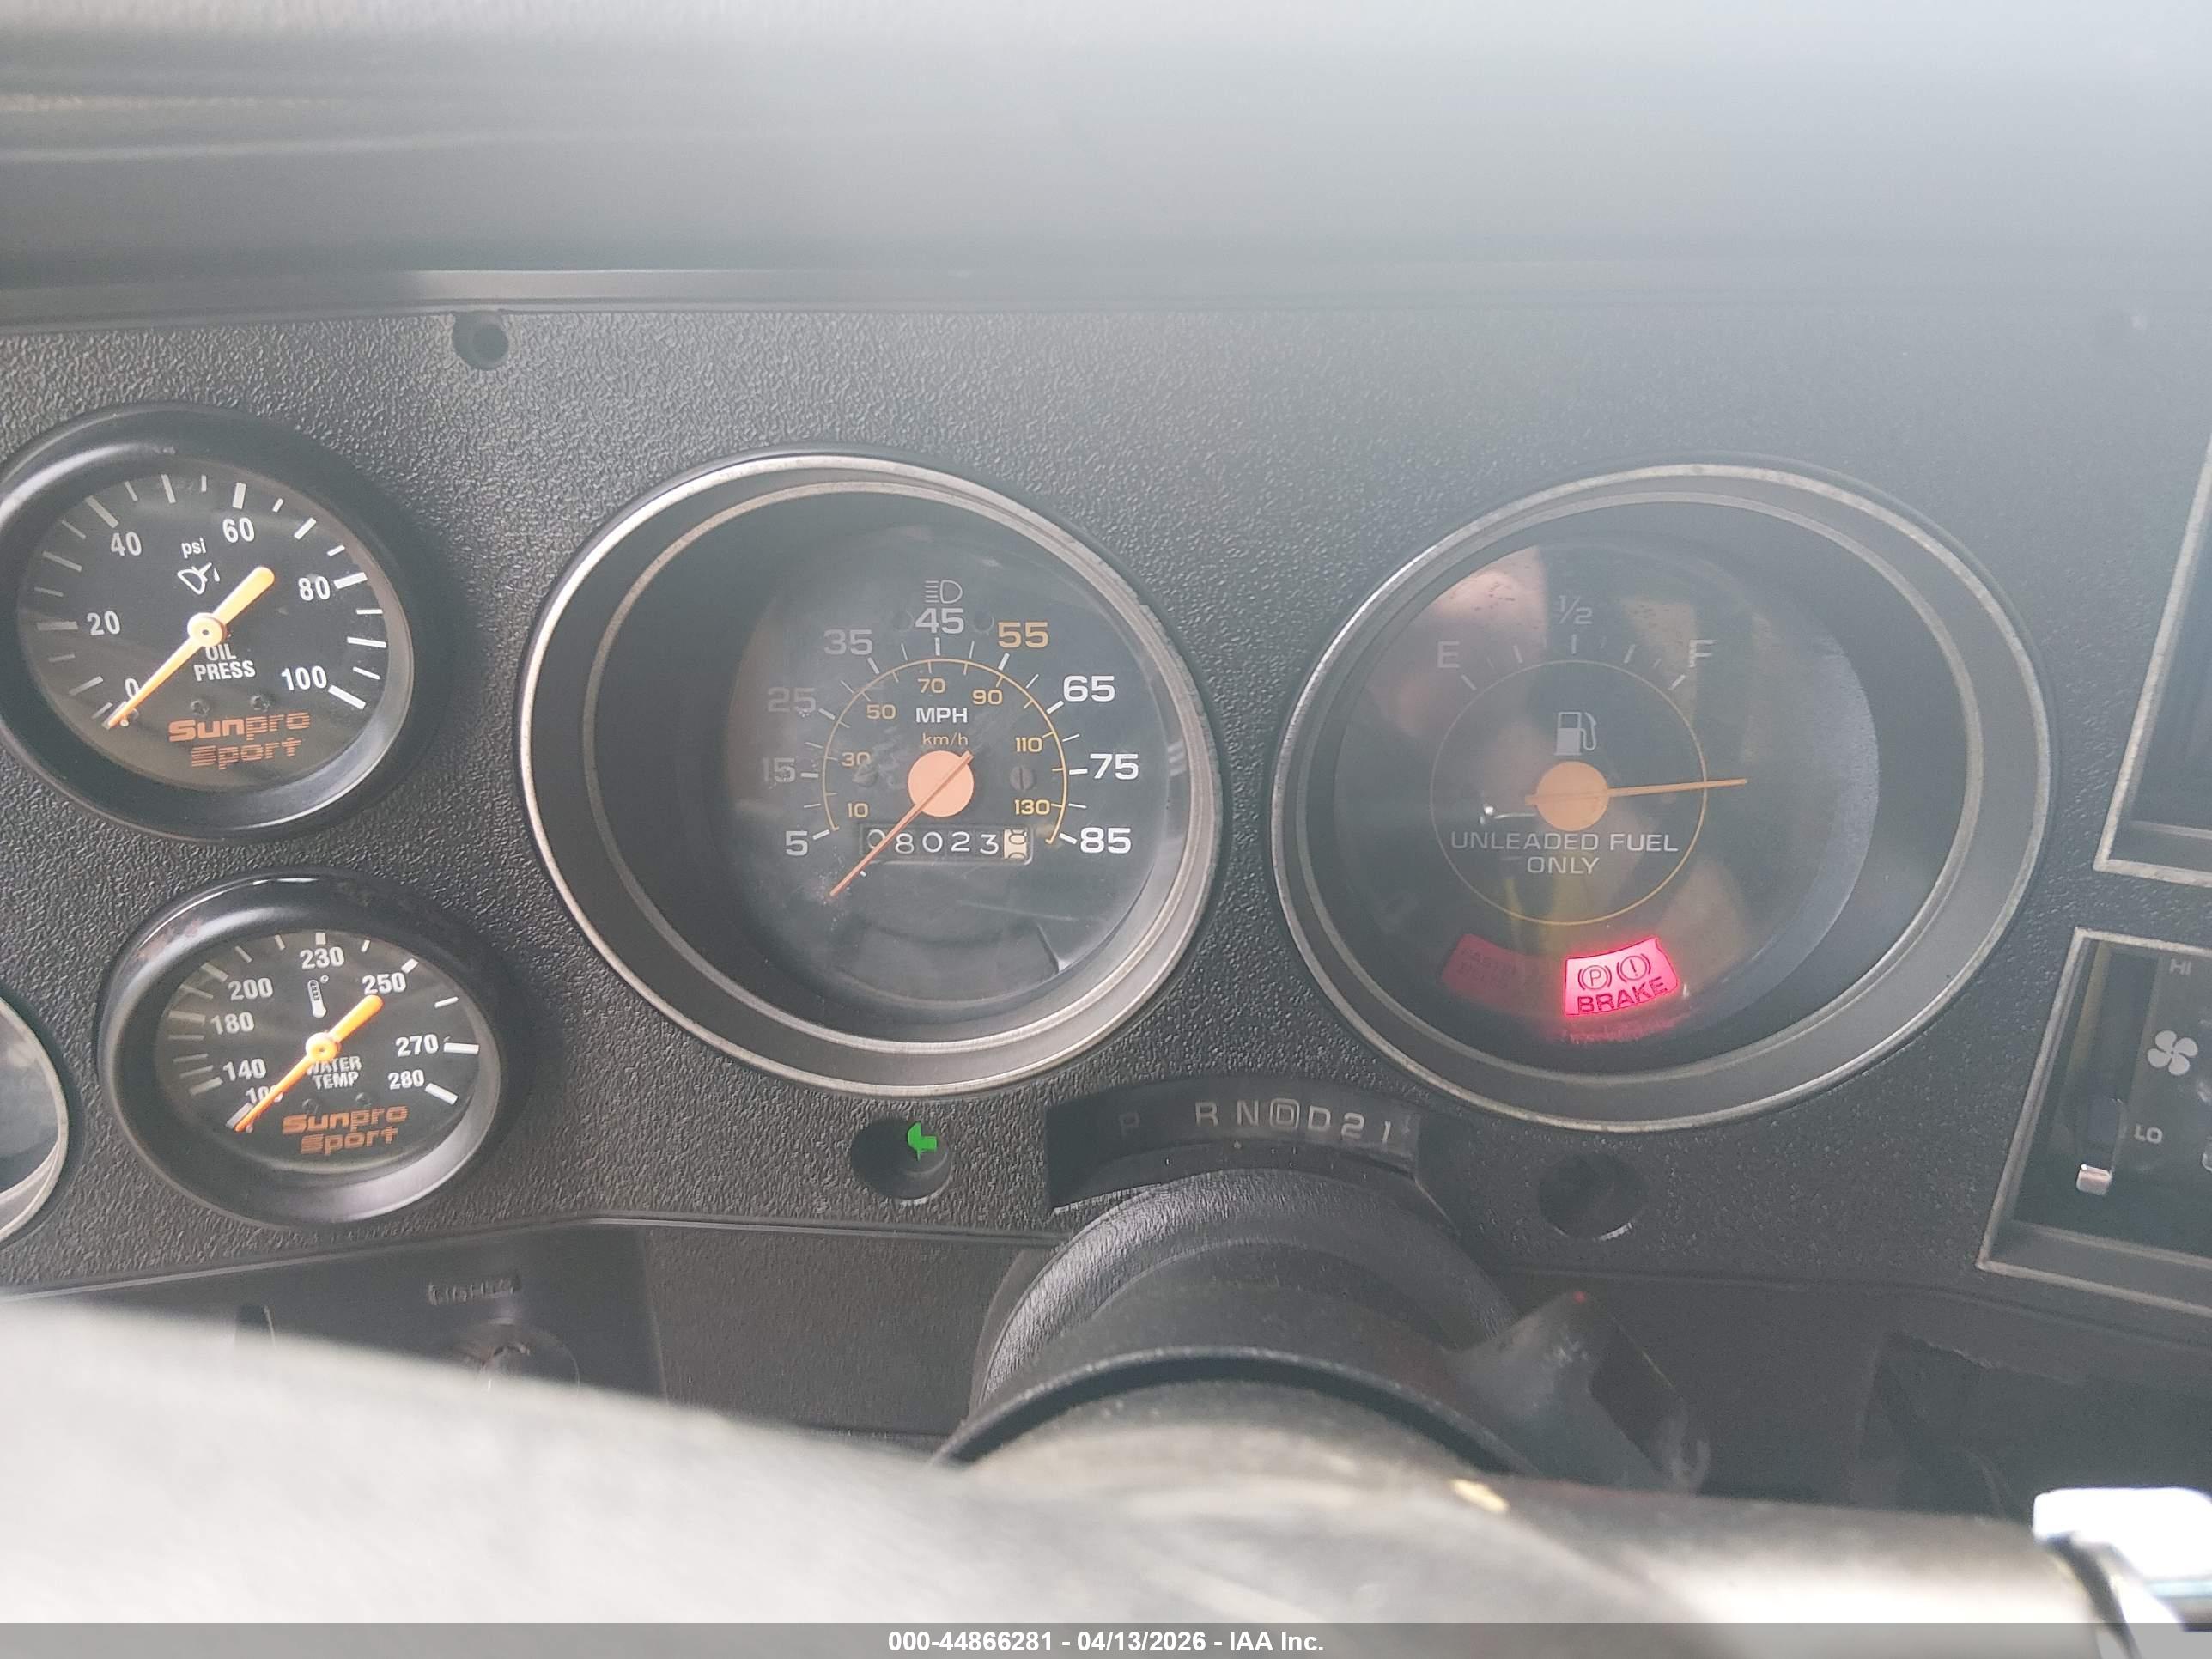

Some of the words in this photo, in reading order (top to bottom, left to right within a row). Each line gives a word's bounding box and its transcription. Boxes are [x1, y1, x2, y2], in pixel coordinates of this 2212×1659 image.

[222, 517, 254, 544] 60
[110, 532, 142, 556] 40
[181, 538, 206, 558] psi
[299, 575, 331, 602] 80
[87, 611, 121, 636] 20
[915, 607, 964, 634] 45
[823, 629, 873, 656] 35
[997, 621, 1049, 648] 55
[205, 643, 237, 660] OIL
[1437, 641, 1460, 669] E
[1689, 639, 1716, 667] F
[194, 660, 255, 681] PRESS
[281, 666, 327, 691] 100
[917, 678, 946, 694] 70
[972, 689, 1003, 706] 90
[1063, 675, 1115, 702] 65
[767, 688, 817, 715] 25
[866, 704, 896, 720] 50
[168, 711, 310, 743] Sunpro
[915, 707, 968, 724] MPH
[921, 732, 969, 747] km/h
[1015, 737, 1042, 753] 110
[191, 737, 301, 770] Sport
[841, 752, 871, 768] 30
[762, 757, 796, 782] 15
[1089, 753, 1139, 781] 75
[847, 803, 868, 818] 10
[1014, 799, 1051, 815] 130
[785, 831, 809, 857] 5
[1079, 827, 1132, 854] 85
[1451, 832, 1598, 852] UNLEADED
[1609, 833, 1679, 852] FUEL
[1527, 857, 1600, 875] ONLY
[300, 946, 344, 971] 230
[2170, 959, 2192, 976] HI
[228, 978, 273, 1001] 200
[362, 972, 406, 996] 250
[1577, 975, 1668, 1014] BRAKE
[210, 1012, 254, 1036] 180
[395, 1033, 439, 1058] 270
[223, 1058, 267, 1082] 140
[307, 1055, 362, 1075] WATER
[312, 1071, 359, 1091] TEMP
[388, 1069, 425, 1091] 280
[282, 1105, 408, 1134] Sunpro
[1194, 1101, 1218, 1127] R
[1236, 1099, 1260, 1127] N
[1307, 1106, 1331, 1133] D
[1340, 1112, 1365, 1140] 2
[300, 1125, 398, 1156] Sport
